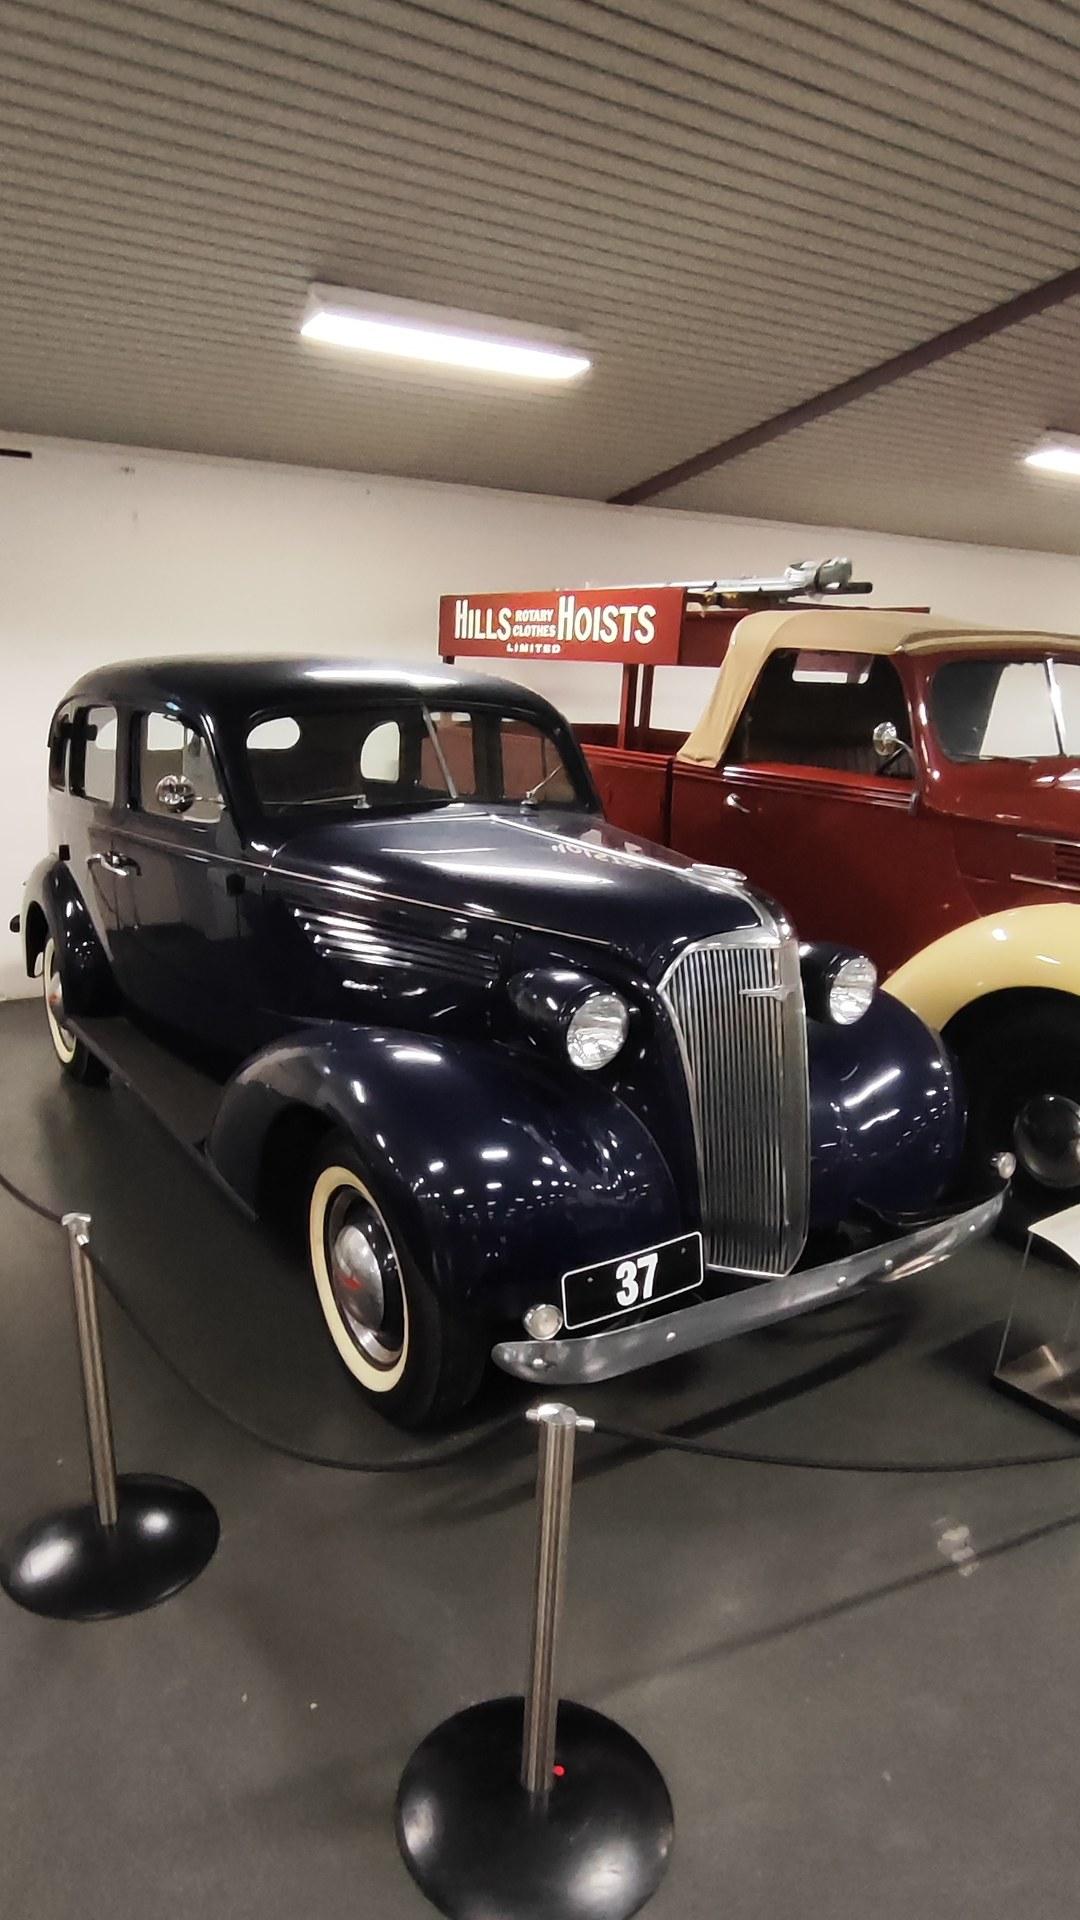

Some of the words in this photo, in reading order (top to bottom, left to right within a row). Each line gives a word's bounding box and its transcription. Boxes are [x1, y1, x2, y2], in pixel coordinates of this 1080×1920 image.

[454, 599, 512, 641] HILLS
[557, 595, 656, 644] HOISTS
[514, 608, 554, 622] ROTARY
[512, 624, 557, 638] CLOTHES
[506, 643, 561, 654] LIMITED
[615, 1252, 658, 1307] 37
